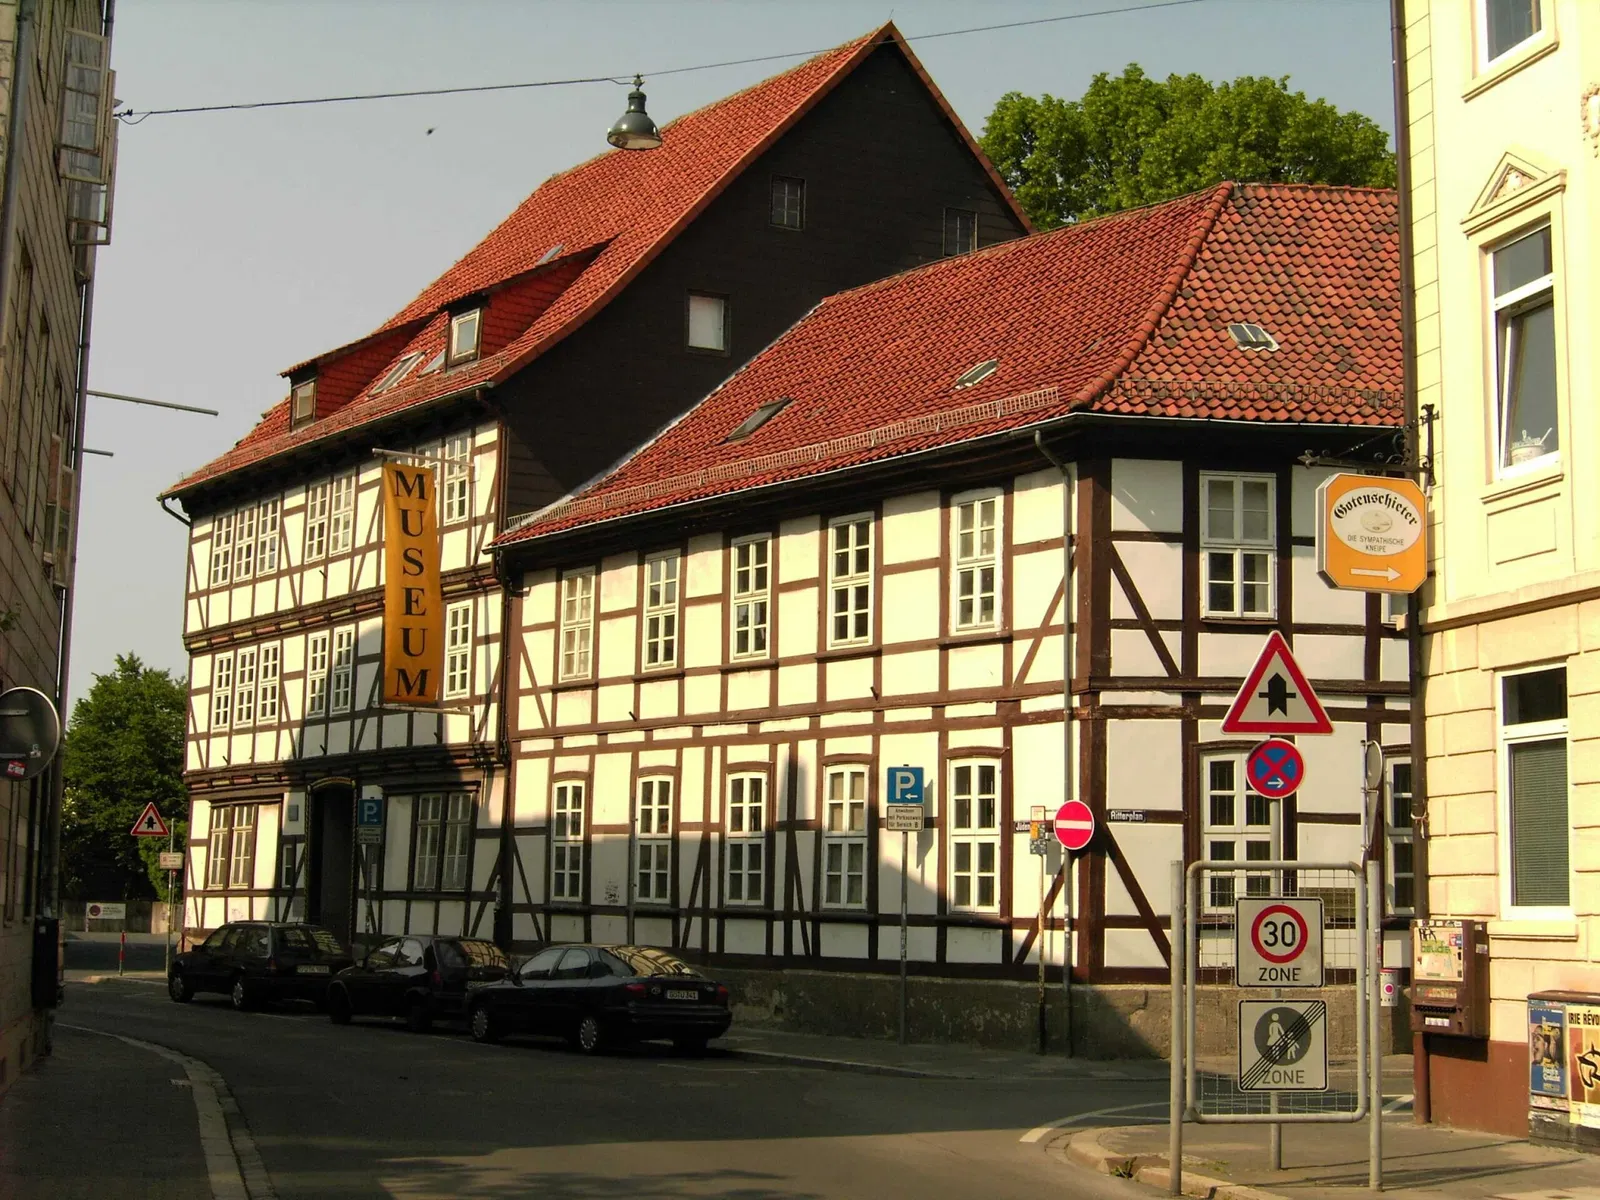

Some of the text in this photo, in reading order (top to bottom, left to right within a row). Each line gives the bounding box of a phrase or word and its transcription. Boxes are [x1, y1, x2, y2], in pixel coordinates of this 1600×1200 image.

[1347, 534, 1405, 546] DIE SYMPATHISCHE
[1365, 544, 1386, 553] KNEIPE
[393, 469, 430, 697] MUSEUM
[895, 771, 915, 799] P
[364, 802, 377, 822] P
[1110, 810, 1144, 822] Ritterplan
[1263, 920, 1296, 948] 30
[1258, 967, 1301, 982] ZONE
[1568, 1012, 1581, 1025] IRIE
[1583, 1009, 1600, 1026] RÉVO
[1262, 1070, 1305, 1085] ZONE
